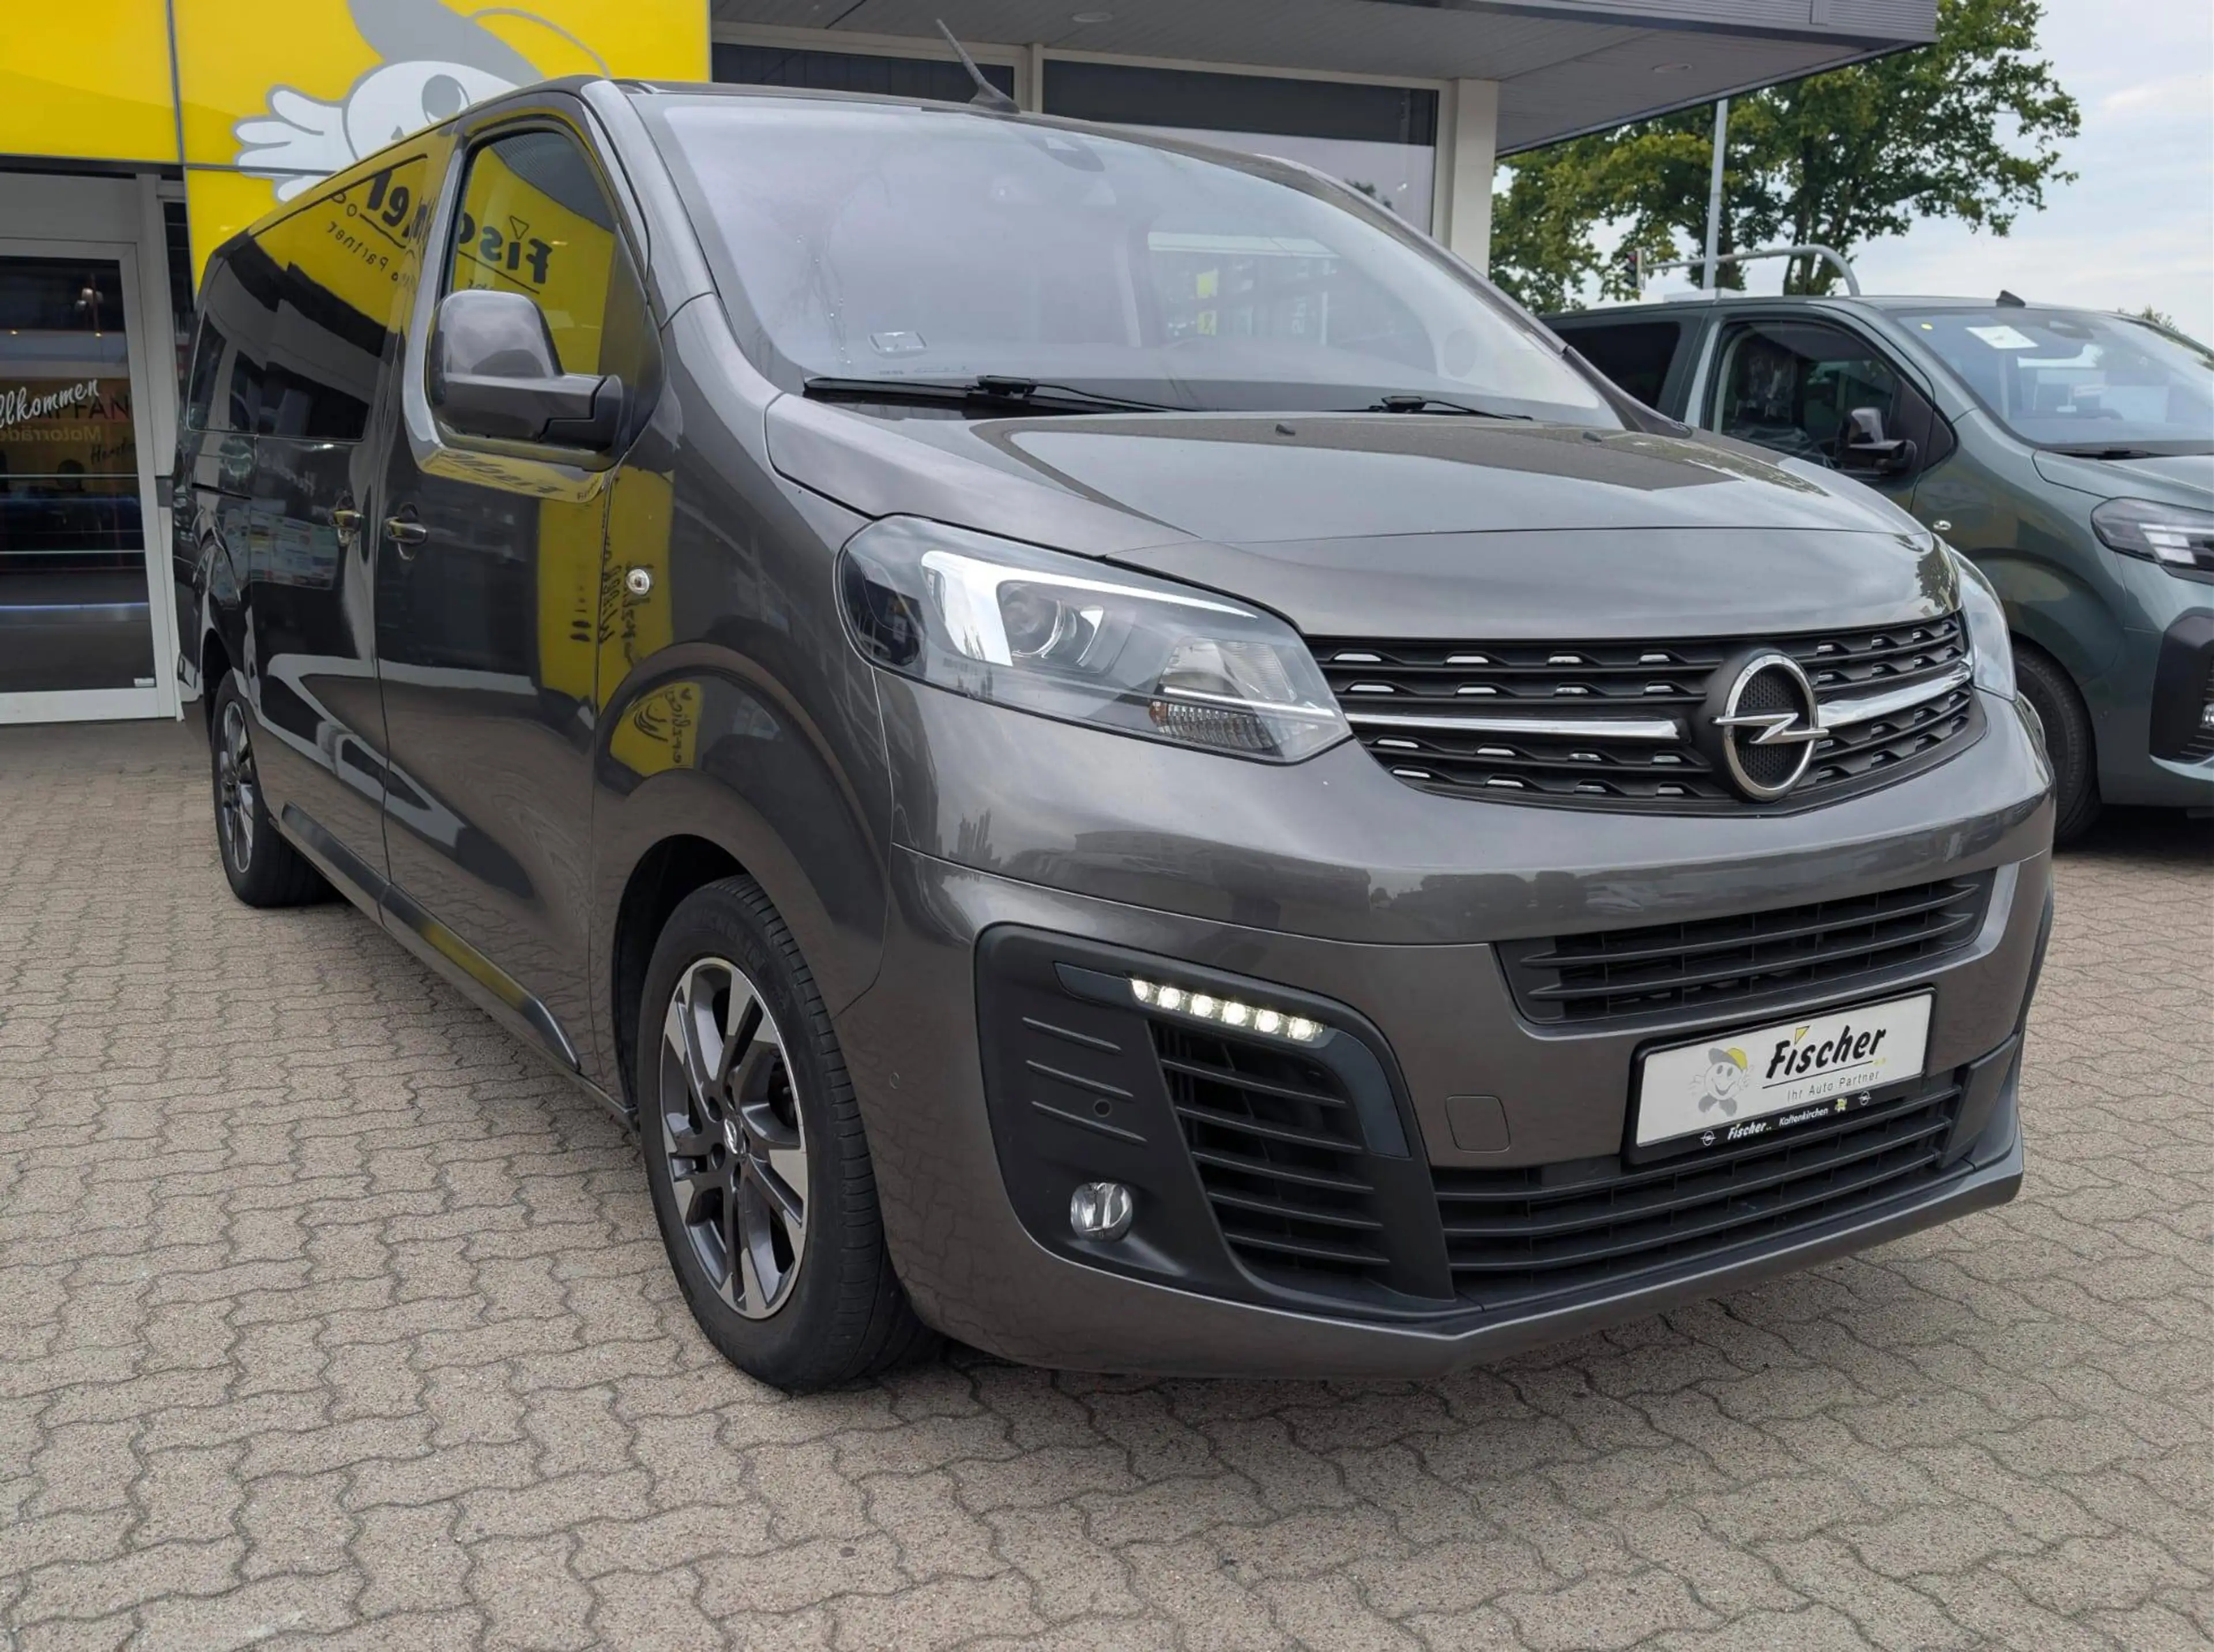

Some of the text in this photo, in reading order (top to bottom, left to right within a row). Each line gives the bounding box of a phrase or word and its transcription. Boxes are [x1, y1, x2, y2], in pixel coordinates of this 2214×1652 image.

[1765, 1025, 1887, 1079] Fischer
[1787, 1071, 1880, 1102] Ihr Auto Partner
[1727, 1107, 1829, 1141] Fischer Kaltenkirchen
